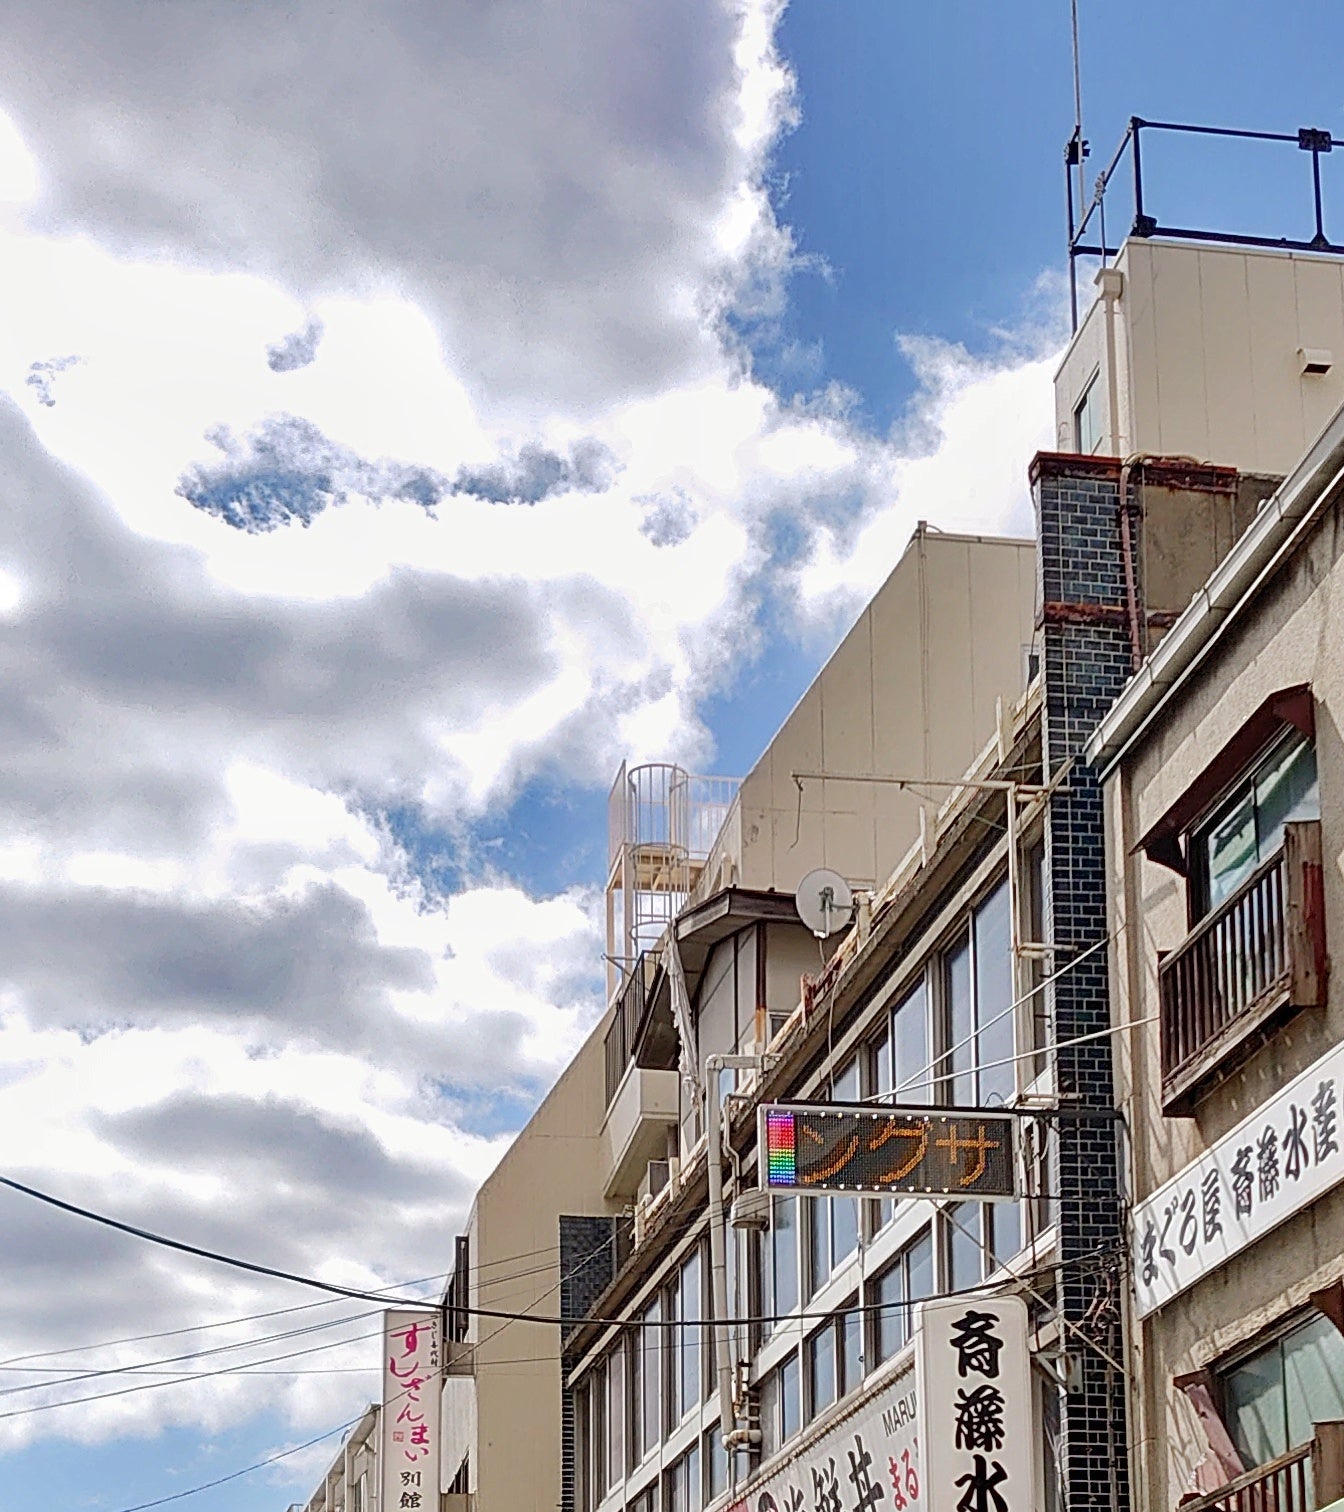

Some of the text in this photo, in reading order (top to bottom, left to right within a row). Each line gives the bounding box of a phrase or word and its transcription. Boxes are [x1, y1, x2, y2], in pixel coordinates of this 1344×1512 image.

[1139, 1168, 1224, 1288] まぐろ屋
[389, 1322, 433, 1462] すしざんまい
[399, 1470, 423, 1510] 別館
[887, 1437, 920, 1511] まる
